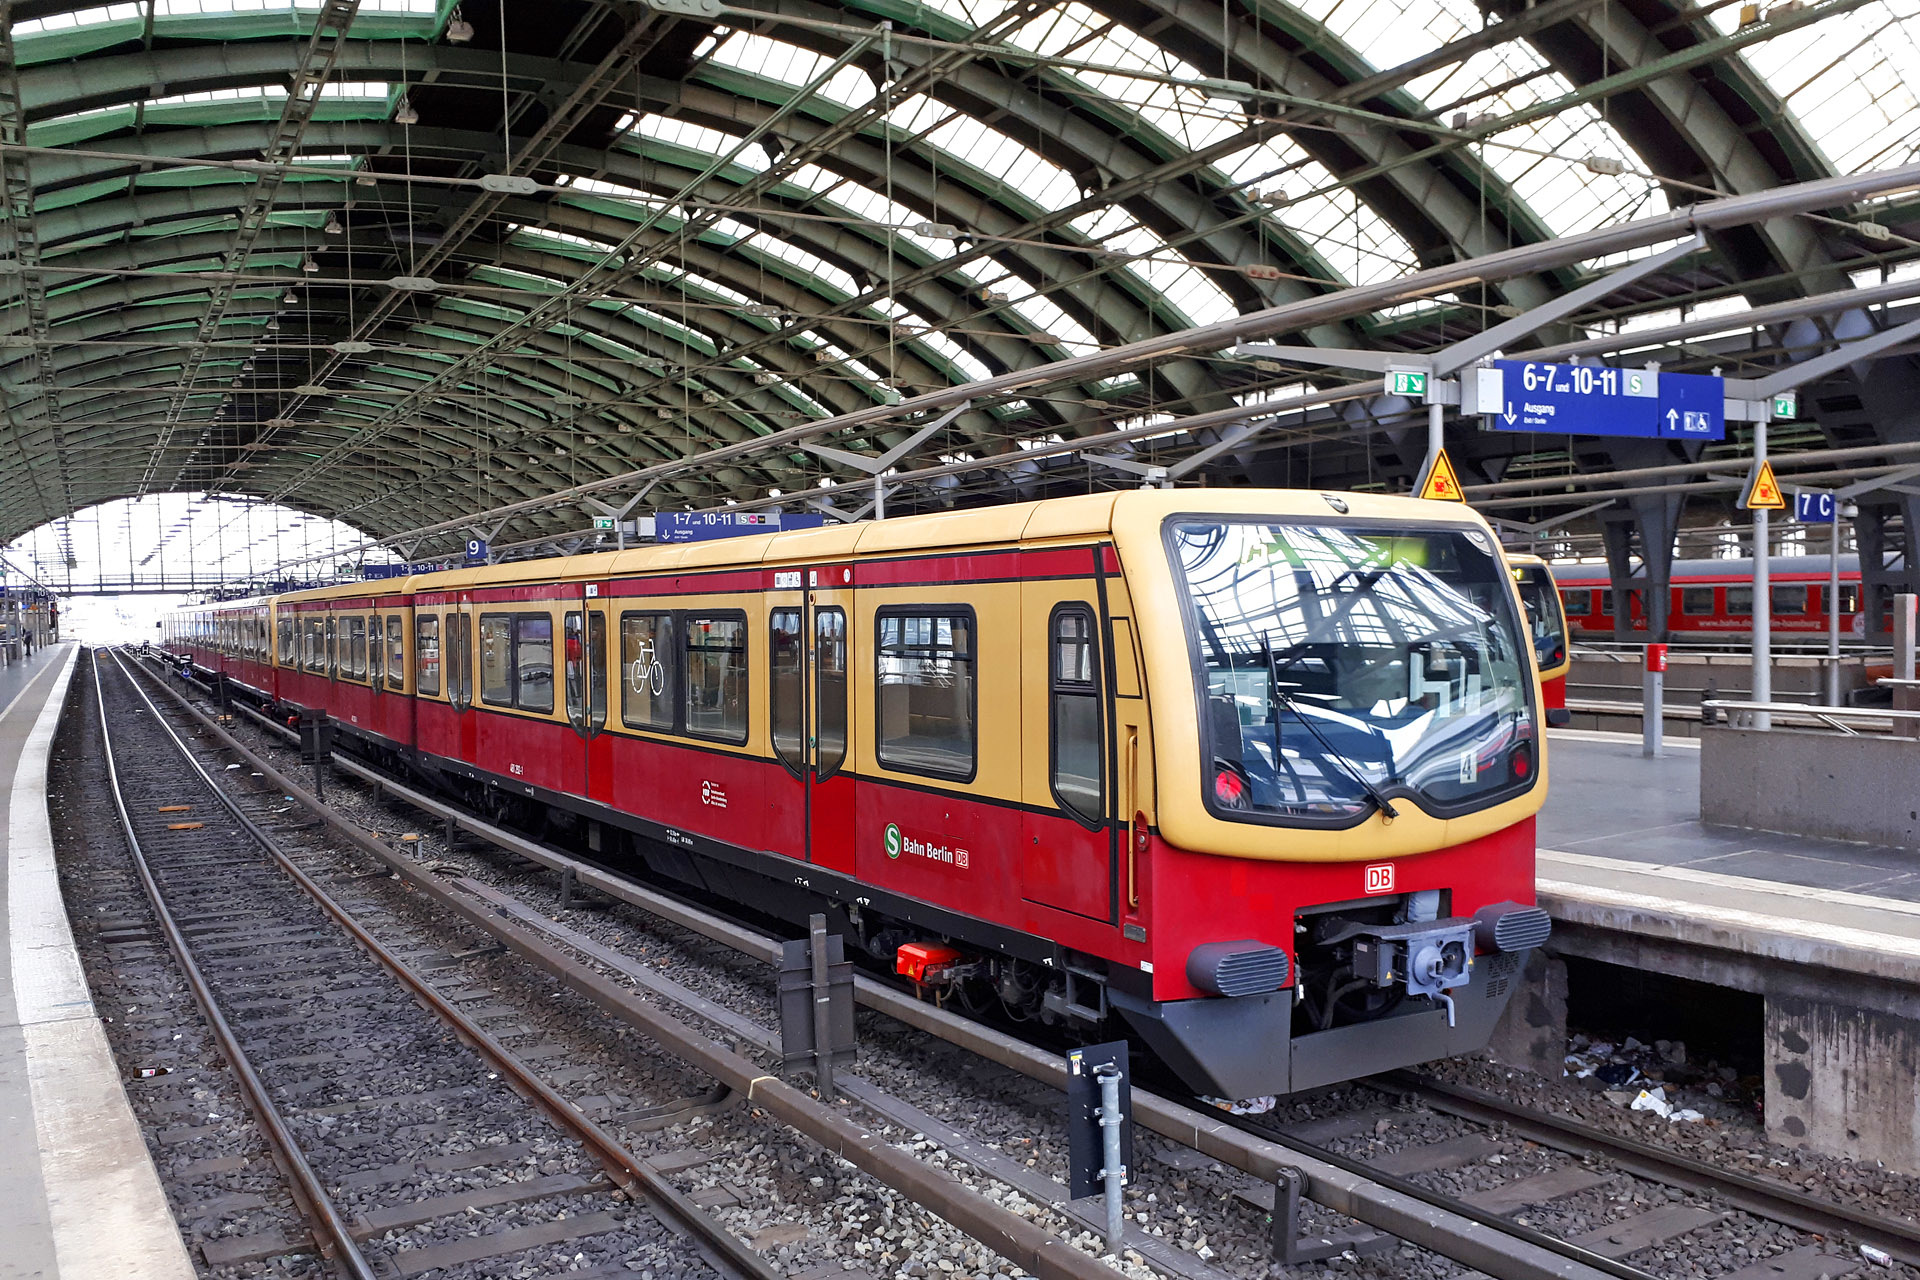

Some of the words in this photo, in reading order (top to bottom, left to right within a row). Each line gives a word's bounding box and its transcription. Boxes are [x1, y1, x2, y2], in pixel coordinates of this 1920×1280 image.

[1522, 363, 1557, 392] 6-7
[1555, 382, 1570, 393] und
[1570, 367, 1617, 396] 10-11
[1630, 374, 1642, 394] S
[1523, 402, 1556, 417] Ausgang
[1801, 494, 1811, 516] 7
[1819, 494, 1831, 516] C
[673, 513, 691, 525] 1-7
[702, 513, 732, 525] 10-11
[469, 540, 480, 555] 9
[1462, 753, 1472, 780] 4
[887, 827, 899, 855] S
[903, 836, 925, 857] Bahn
[926, 842, 953, 864] Berlin
[1369, 868, 1391, 888] DB
